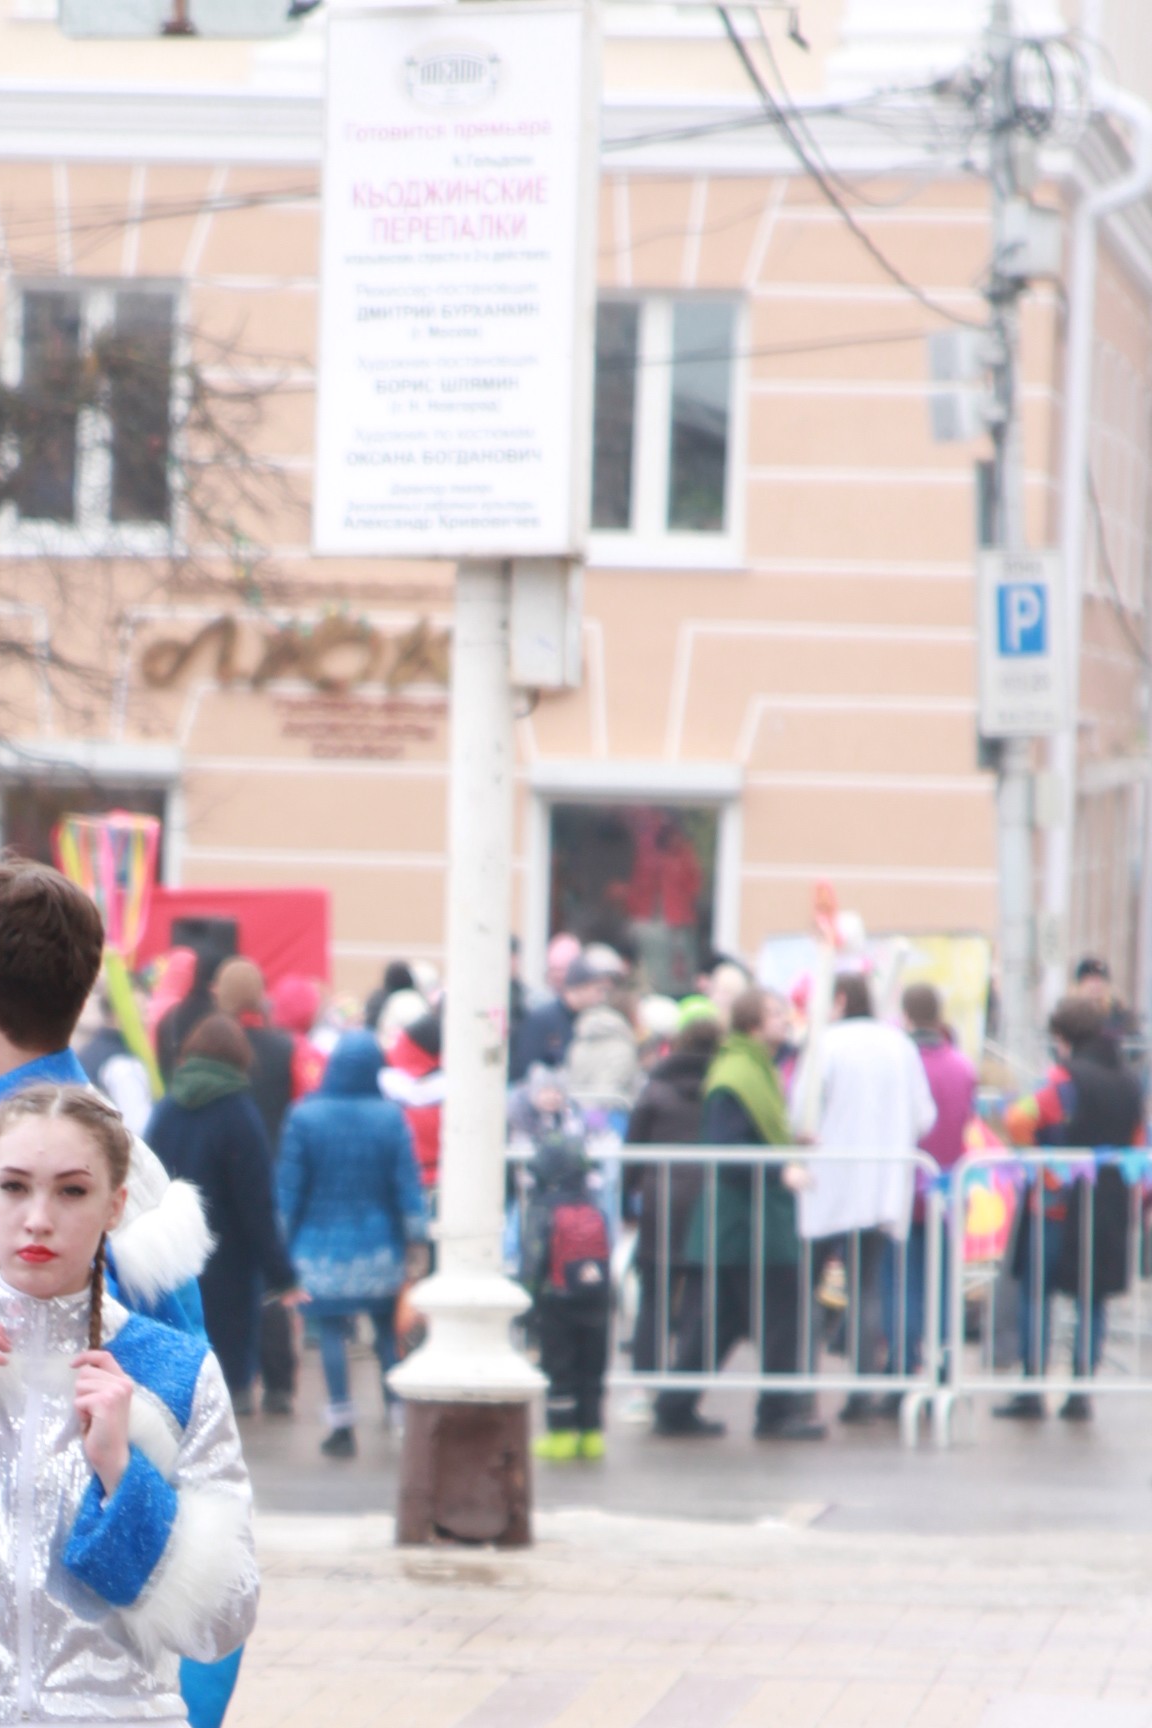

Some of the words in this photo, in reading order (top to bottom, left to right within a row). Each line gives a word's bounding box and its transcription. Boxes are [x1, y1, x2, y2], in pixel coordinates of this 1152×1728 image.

[344, 122, 447, 142] Готовится
[454, 119, 553, 142] премьера
[352, 175, 550, 211] КЬОДЖИНСКИЕ
[372, 213, 528, 245] ПЕРЕПАЛКИ
[375, 378, 435, 395] БОРИС
[346, 450, 416, 466] ОКСАНА
[422, 448, 543, 466] БОГДАНОВИЧ
